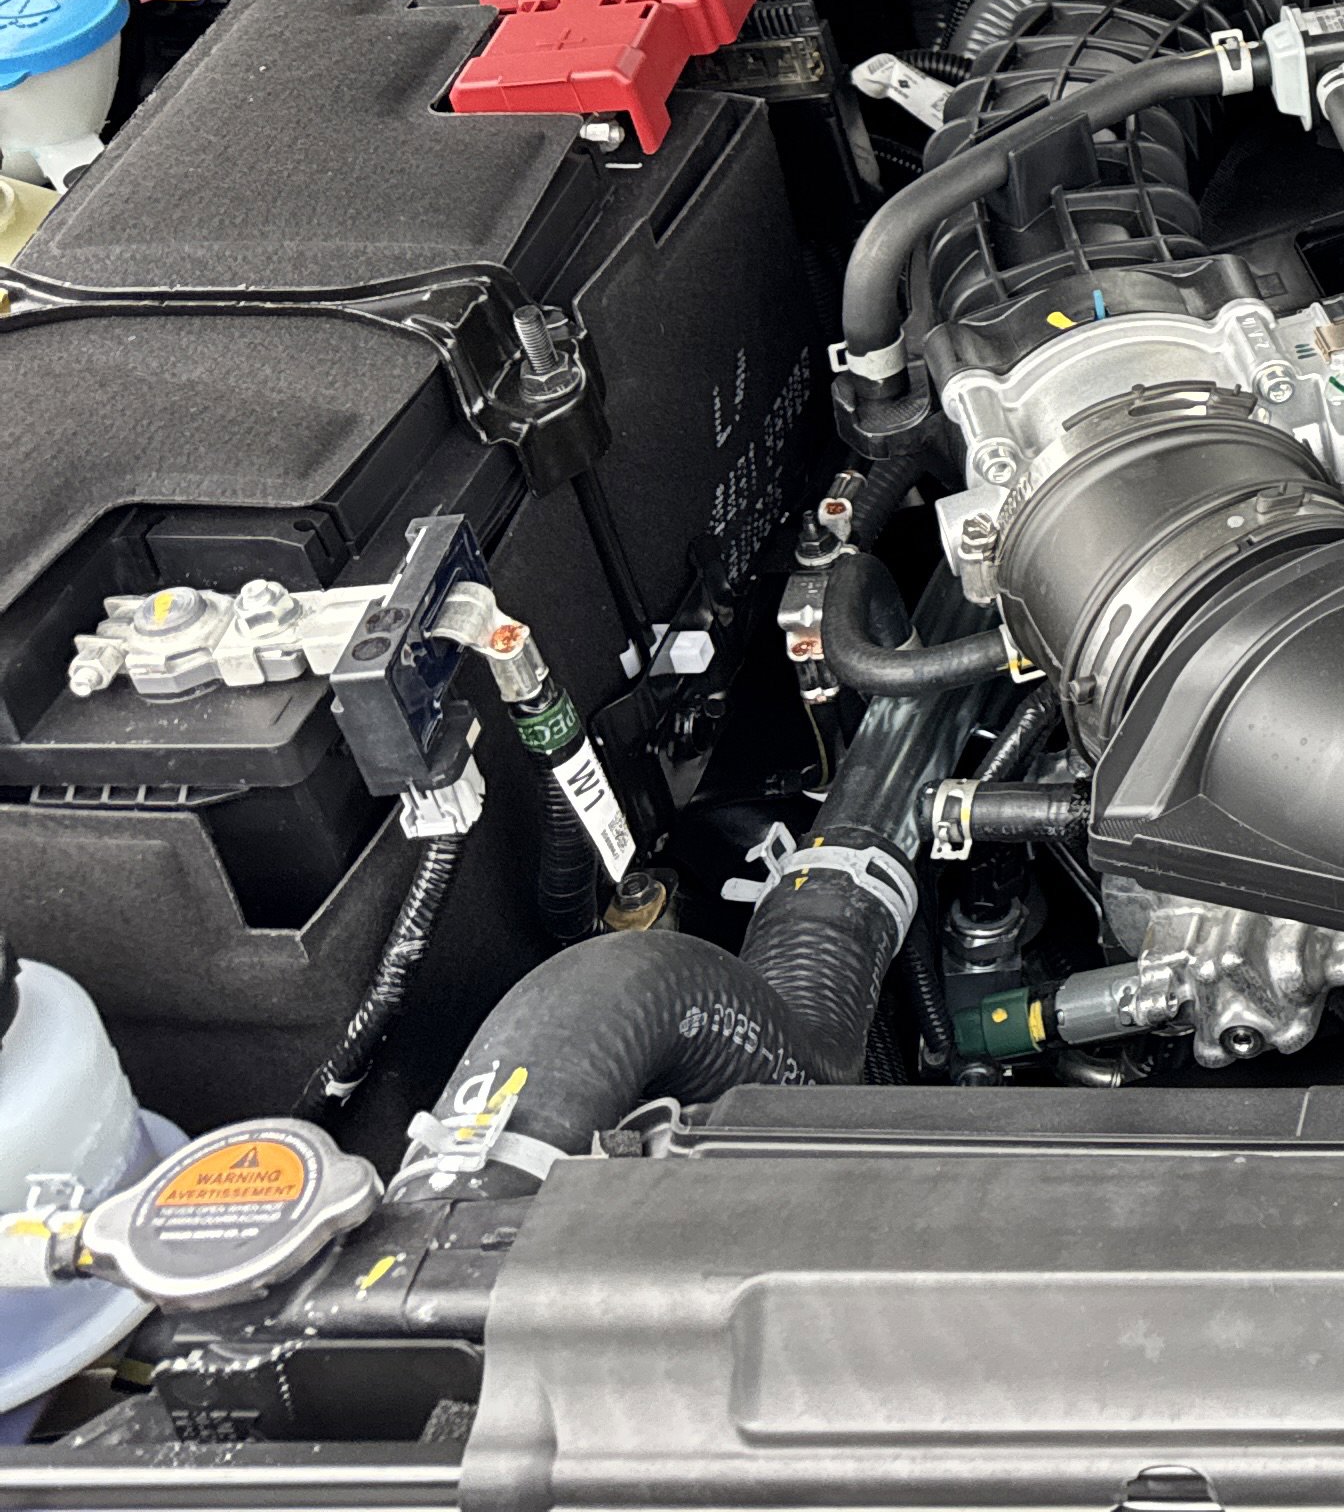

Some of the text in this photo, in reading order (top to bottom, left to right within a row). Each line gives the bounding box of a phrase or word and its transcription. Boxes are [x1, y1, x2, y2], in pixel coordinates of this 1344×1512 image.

[566, 759, 605, 813] W1
[196, 1170, 282, 1185] WARNING
[166, 1184, 296, 1200] AVERTISSEMENT
